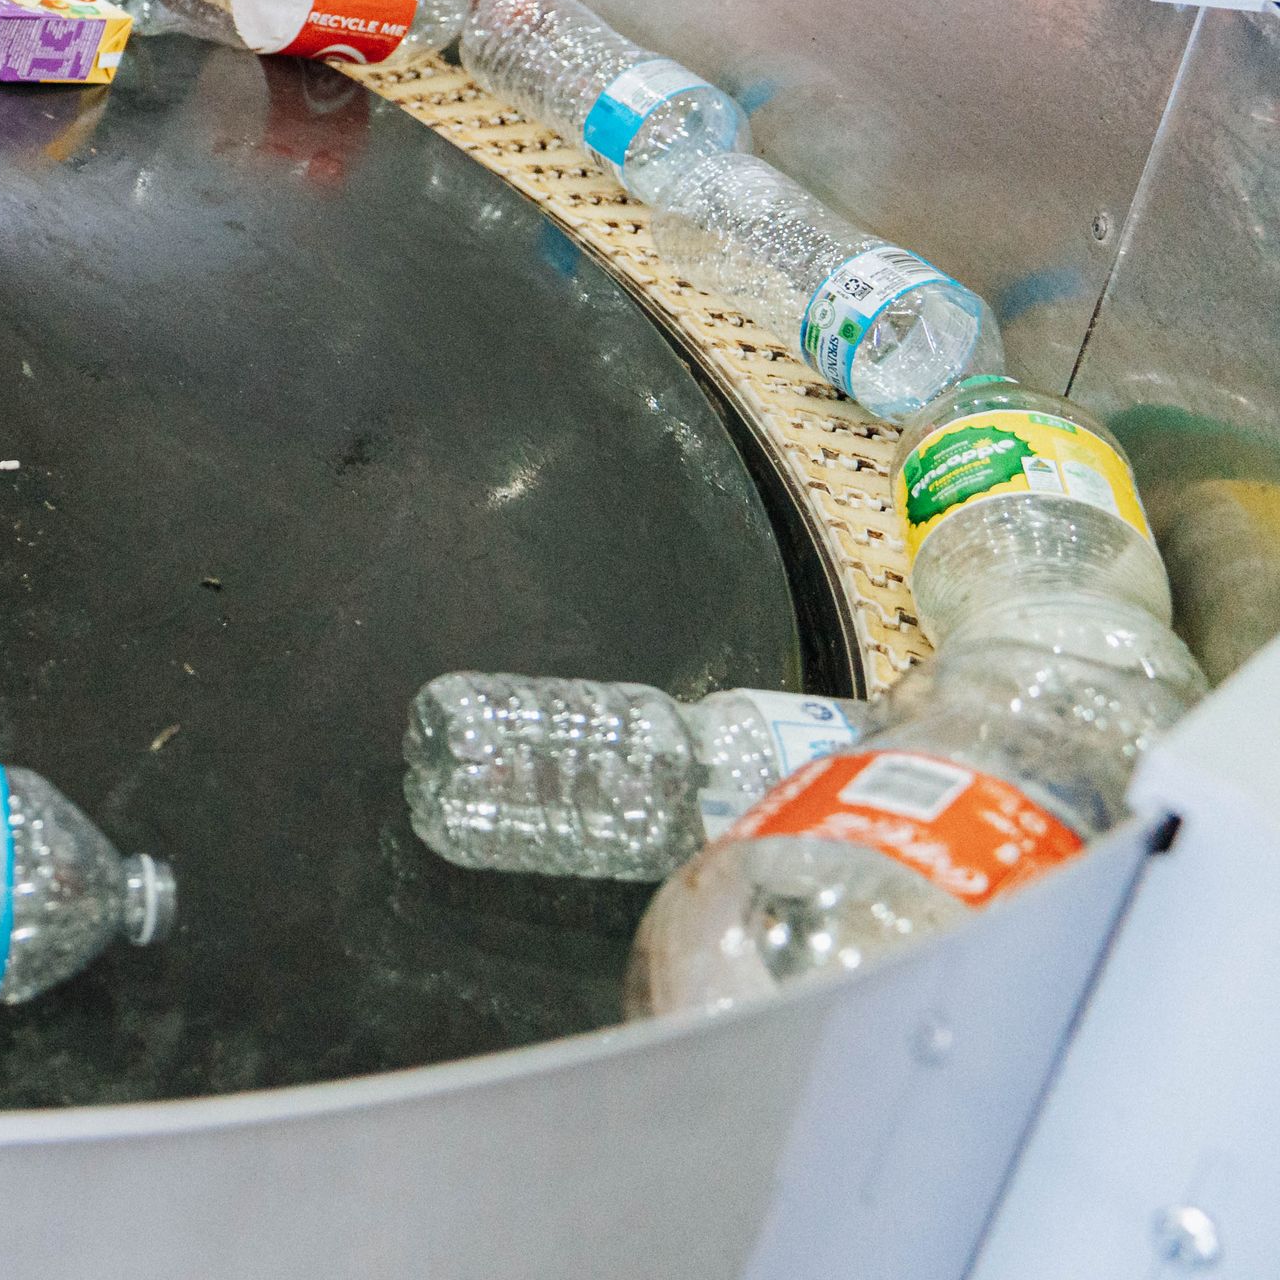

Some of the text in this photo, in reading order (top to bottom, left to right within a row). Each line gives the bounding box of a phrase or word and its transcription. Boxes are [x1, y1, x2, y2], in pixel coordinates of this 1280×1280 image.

[308, 11, 410, 37] RECYCLE ME
[825, 333, 840, 377] SPRING
[910, 439, 1016, 500] Pineapple
